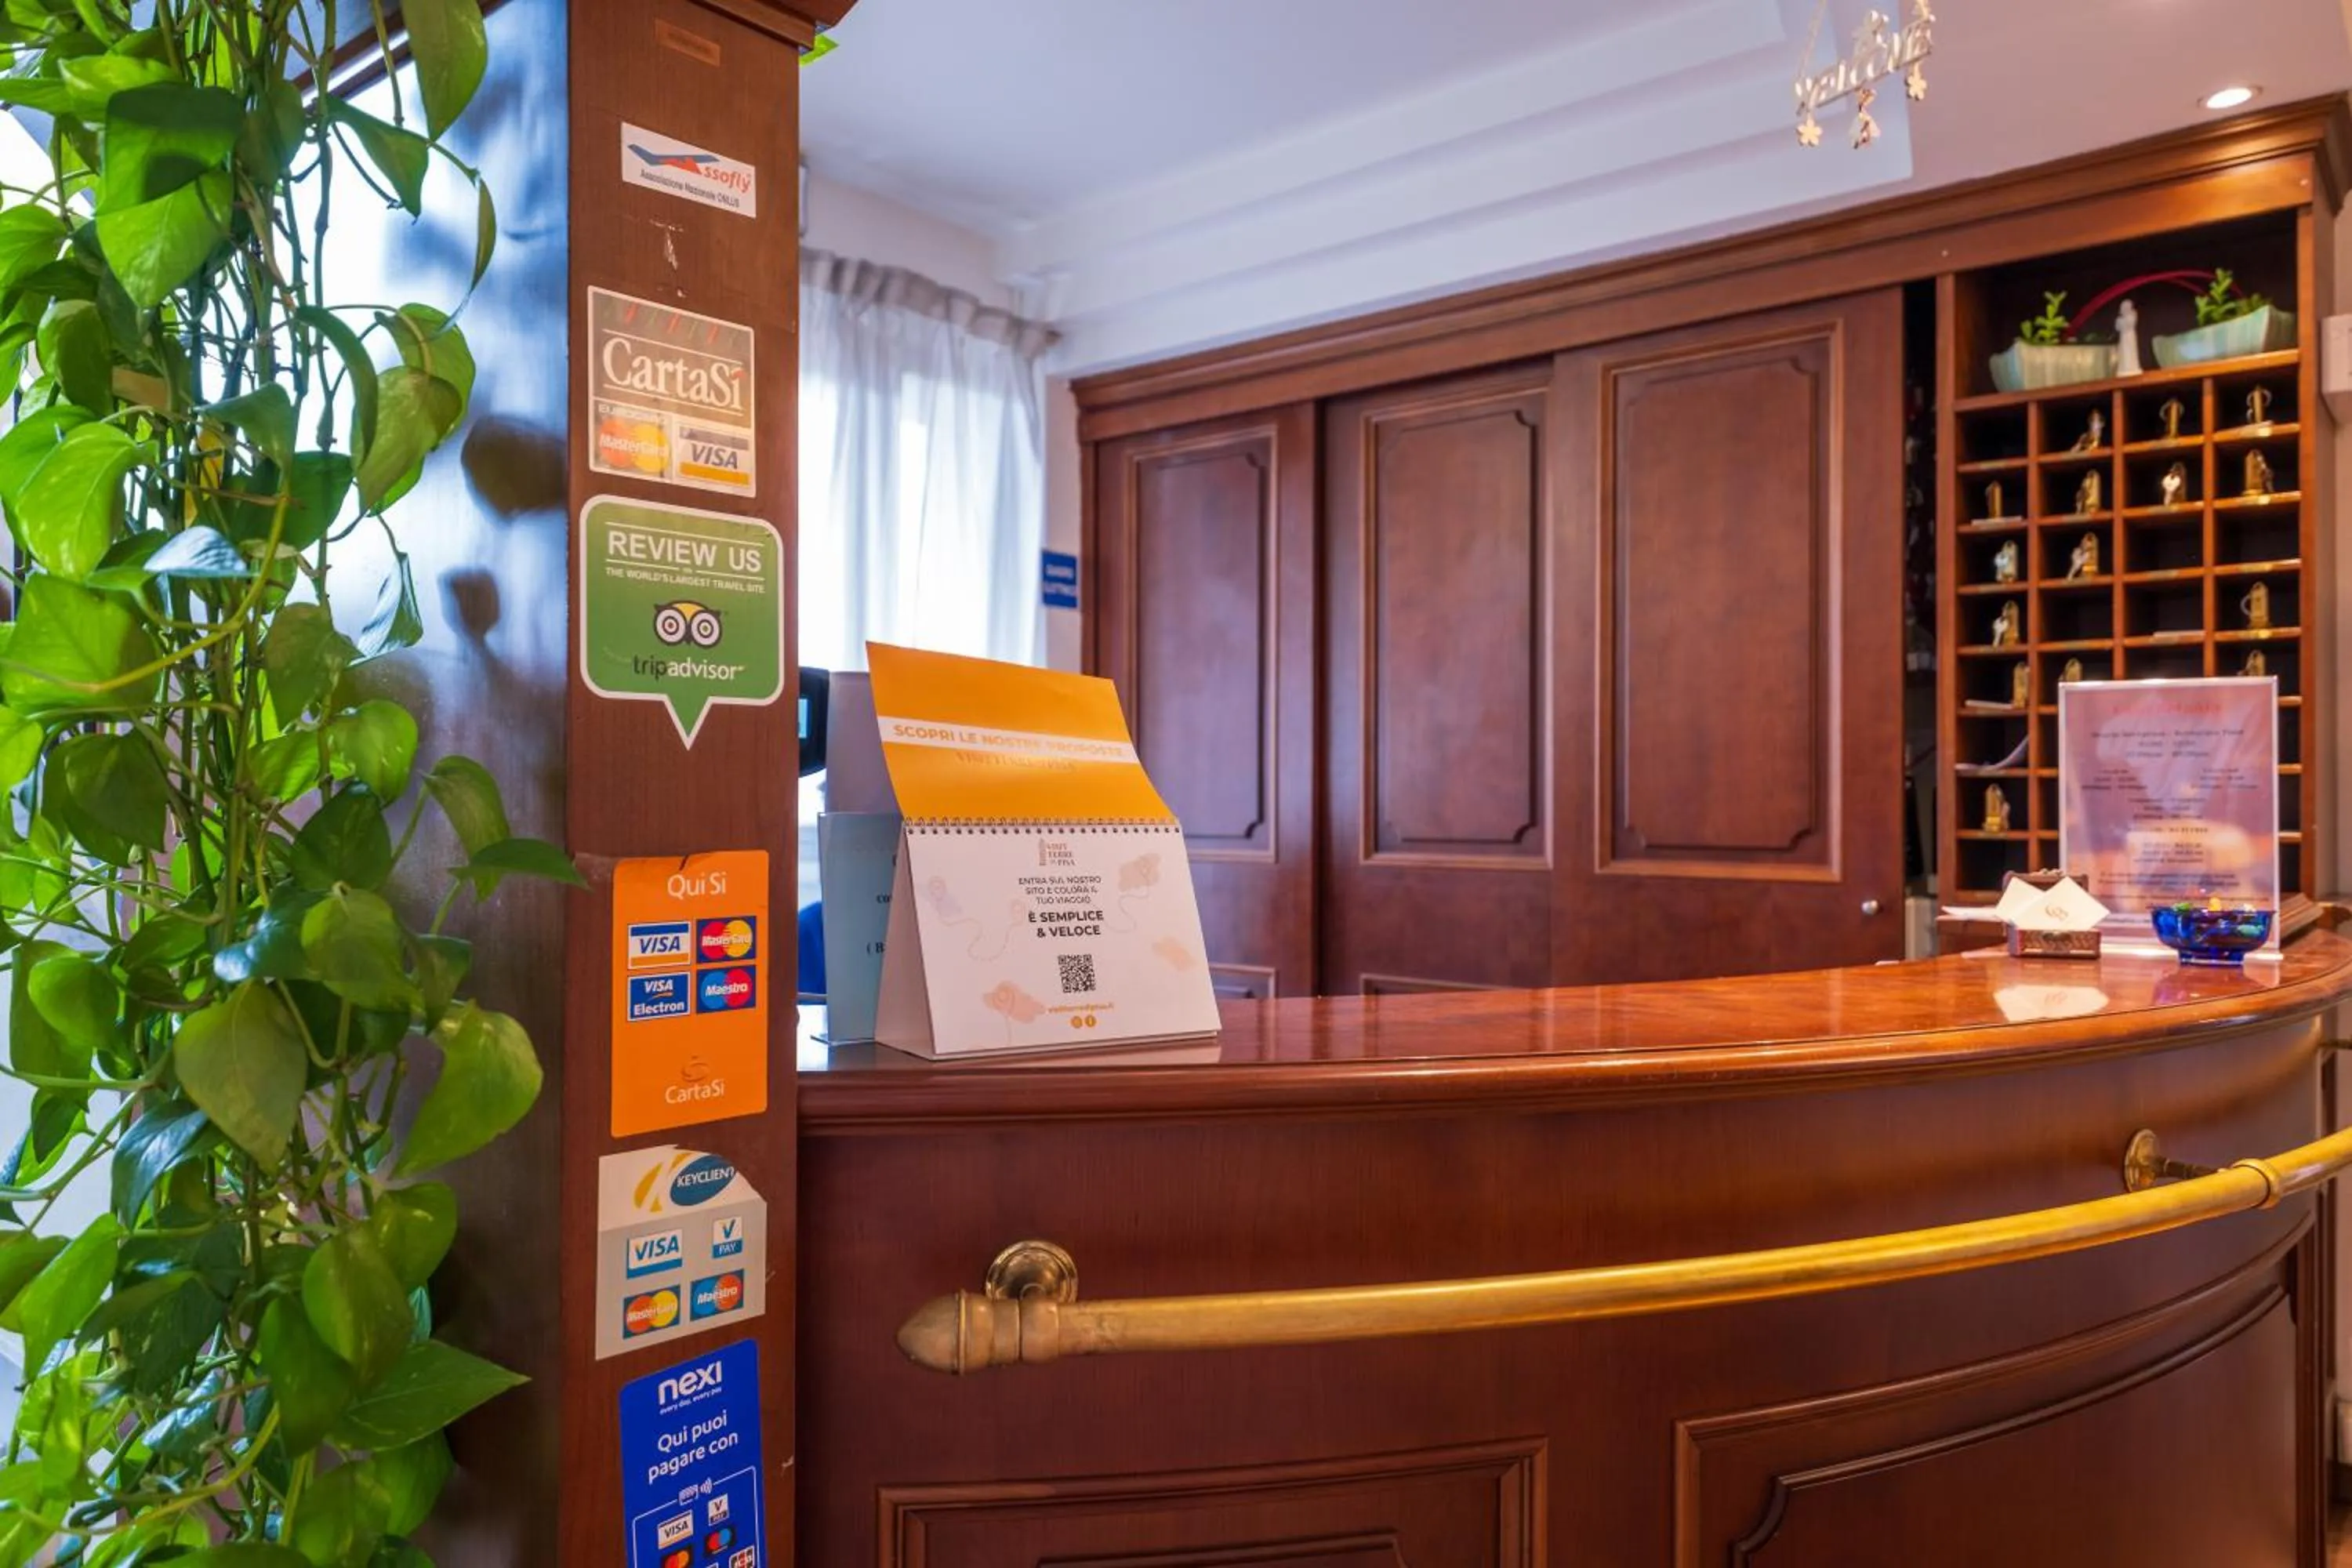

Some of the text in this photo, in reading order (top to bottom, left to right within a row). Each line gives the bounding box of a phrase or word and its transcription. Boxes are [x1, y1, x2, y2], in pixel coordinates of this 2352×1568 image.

[691, 443, 739, 469] VISA
[608, 530, 762, 572] REVIEW US
[605, 567, 623, 578] THE
[669, 575, 710, 588] LARGEST
[712, 579, 745, 592] TRAVEL
[746, 583, 765, 593] SITE
[633, 654, 737, 681] tripadvisor
[893, 724, 955, 742] SCOPRI
[959, 731, 977, 744] LE
[1040, 910, 1104, 923] SEMPLICE
[639, 931, 753, 954] VISA MasterCard
[1036, 925, 1102, 938] & VELOCE
[644, 979, 749, 996] VISA Maestro
[633, 1001, 685, 1016] Electron
[635, 1235, 680, 1261] VISA
[719, 1243, 737, 1255] PAY
[697, 1287, 739, 1305] Maestro
[657, 1360, 722, 1406] nexi
[657, 1410, 728, 1453] Qui puoi
[648, 1432, 739, 1485] pagare con
[664, 1521, 688, 1538] VISA
